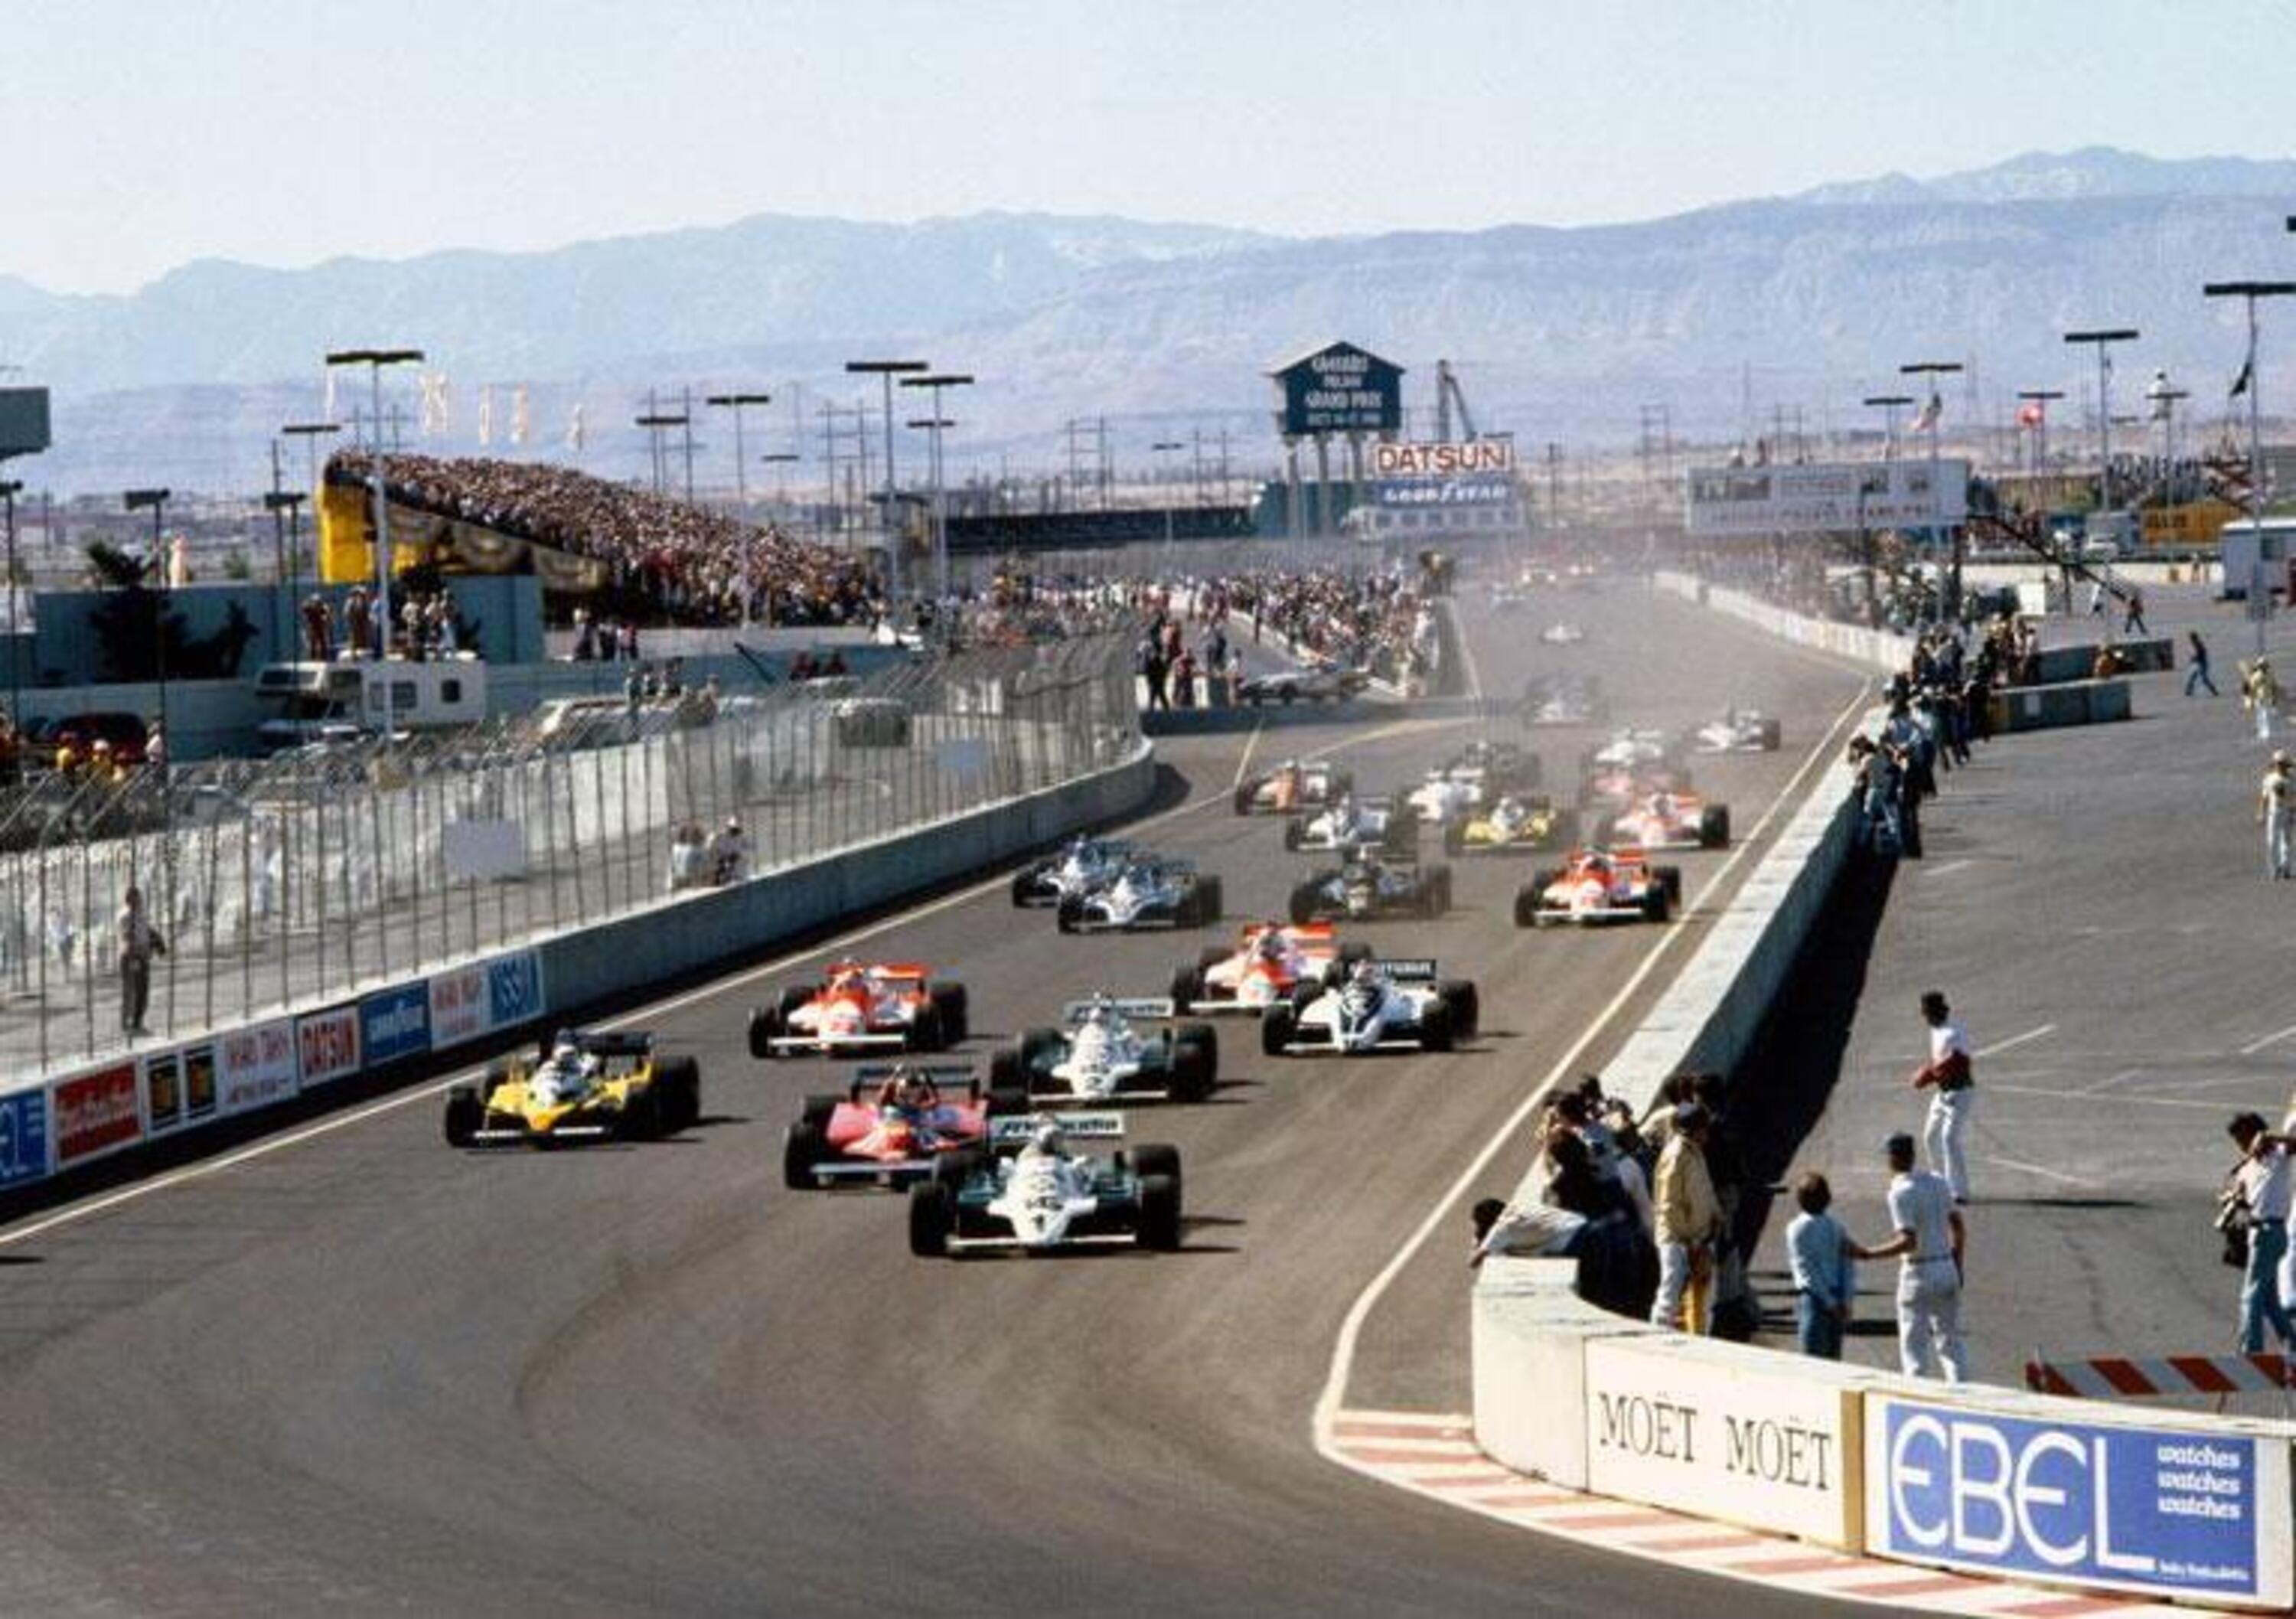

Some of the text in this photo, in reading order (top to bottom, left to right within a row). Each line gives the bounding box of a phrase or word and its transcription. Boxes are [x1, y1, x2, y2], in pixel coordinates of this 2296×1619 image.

[1378, 444, 1505, 472] DATSUN
[1384, 481, 1506, 502] GOODYEAR
[1599, 1391, 1831, 1490] MOËT MOËT
[2157, 1444, 2240, 1470] watches
[1891, 1415, 2157, 1572] EBEL
[2157, 1470, 2240, 1495] watches
[2157, 1495, 2240, 1519] watches
